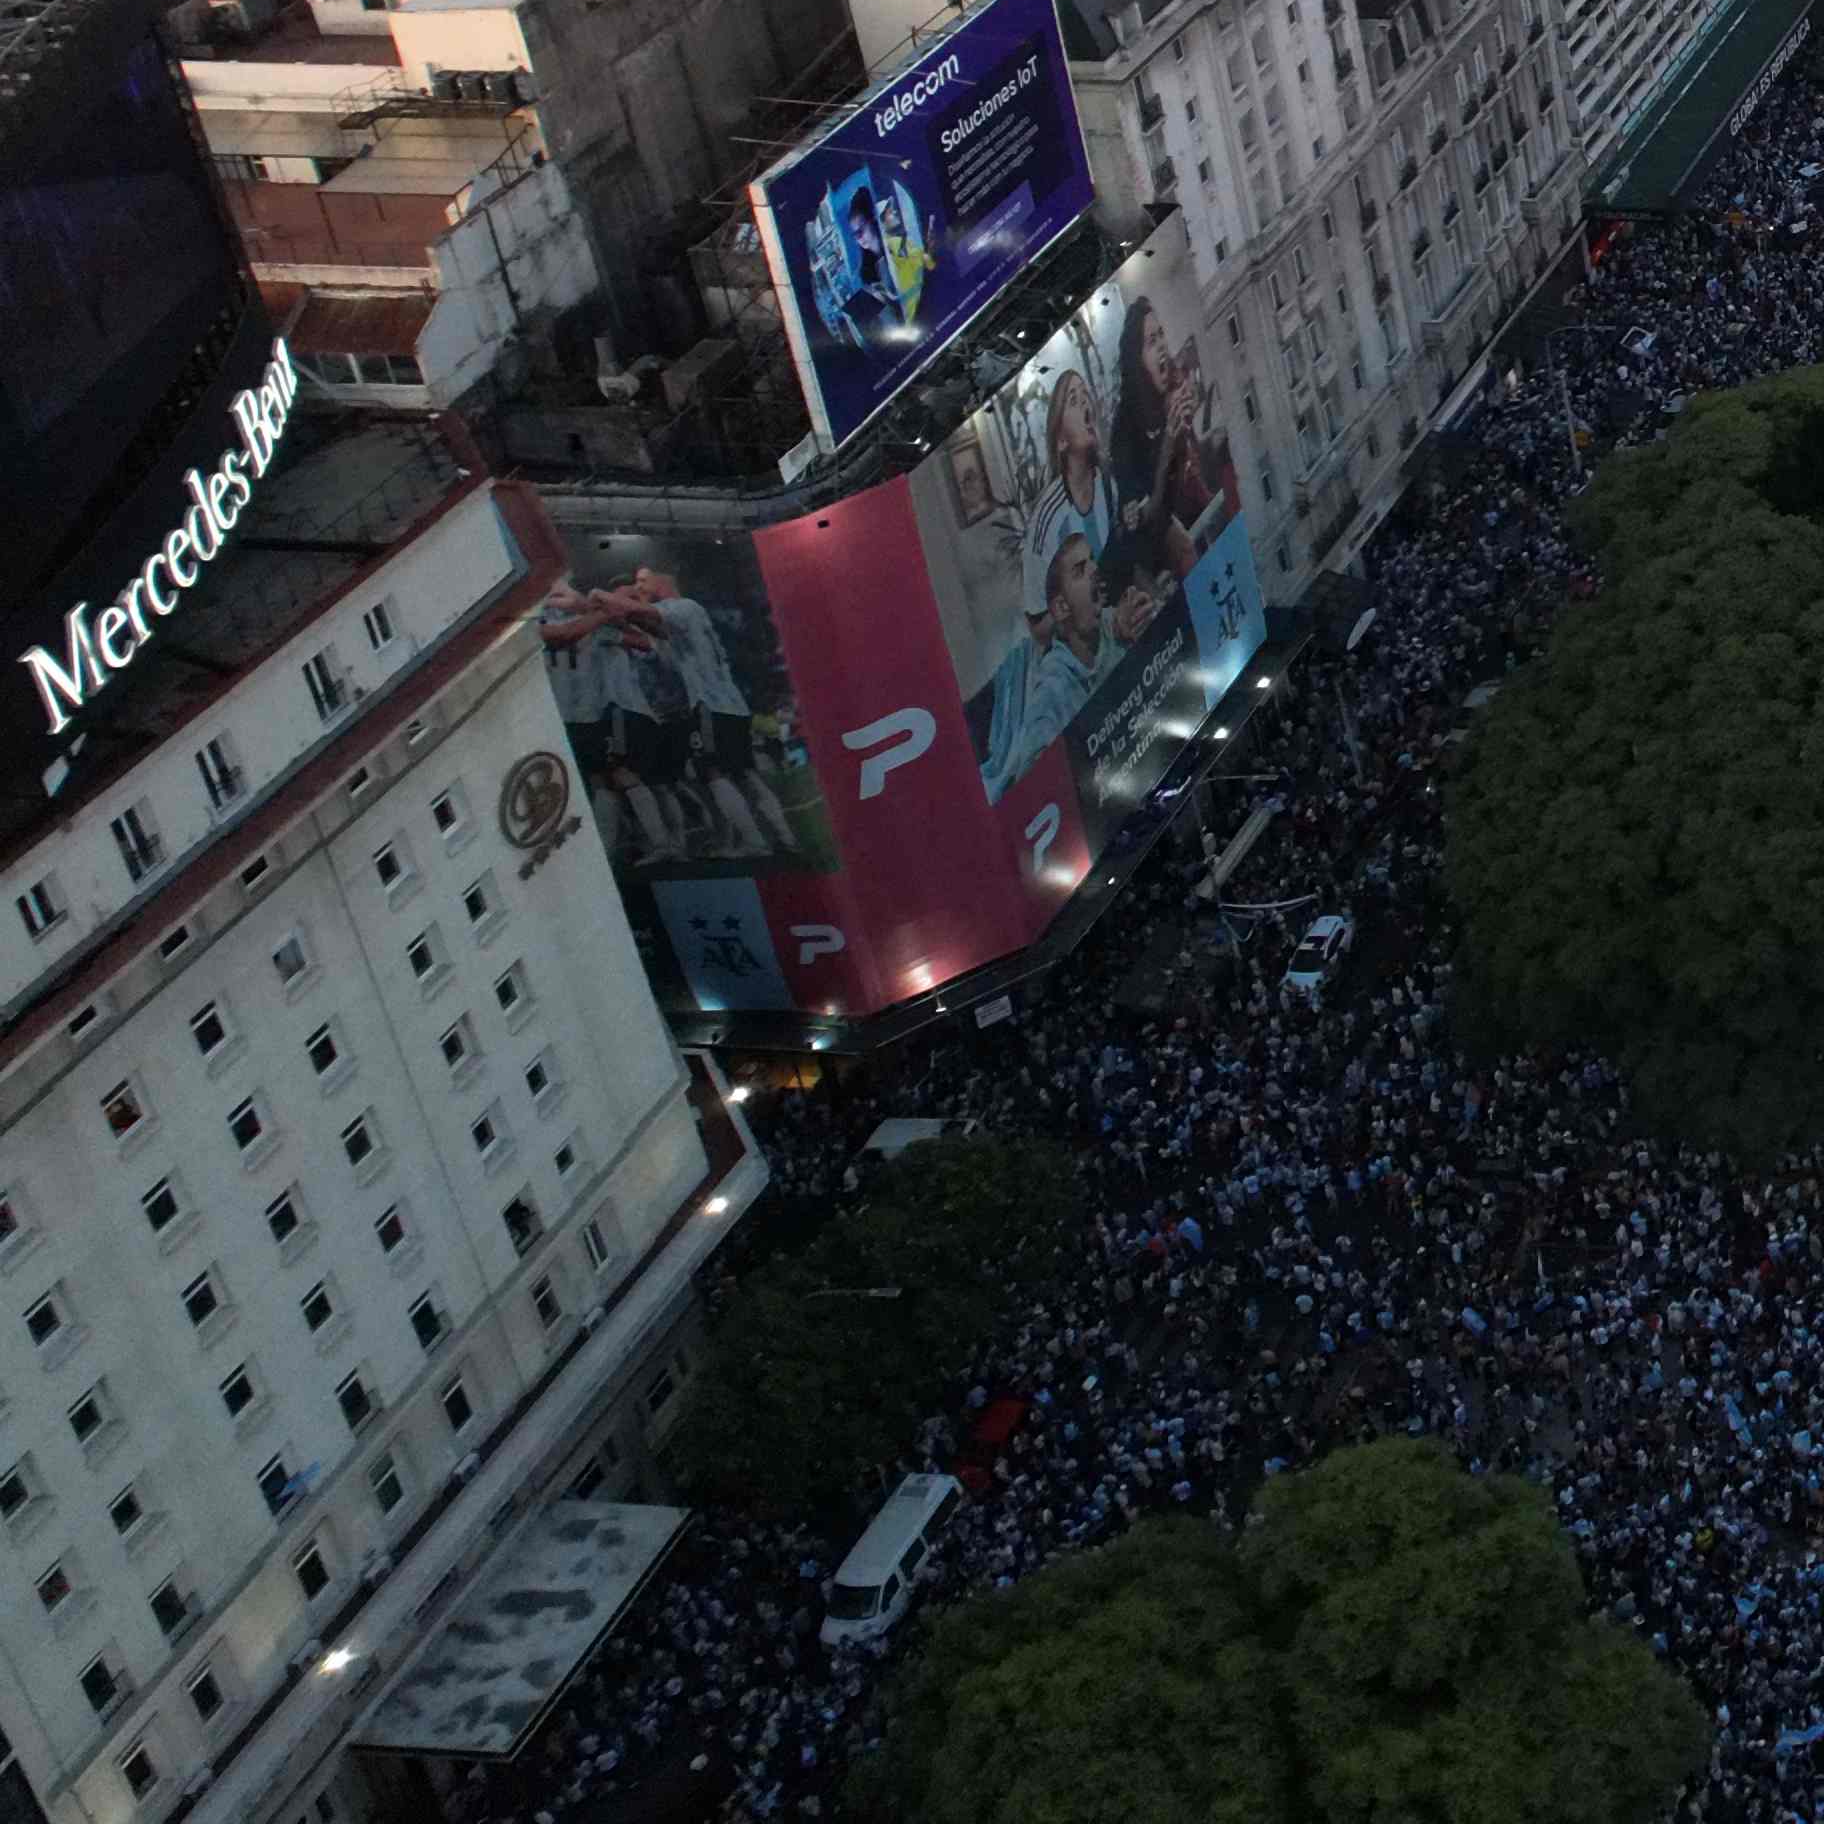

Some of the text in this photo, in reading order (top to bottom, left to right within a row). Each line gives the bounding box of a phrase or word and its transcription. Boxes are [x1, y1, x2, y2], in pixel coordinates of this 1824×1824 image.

[874, 54, 960, 138] telecom
[941, 55, 1038, 153] Soluciones IoT
[17, 336, 298, 735] Mercedes-Benz
[1087, 626, 1184, 757] Delivery Oficial
